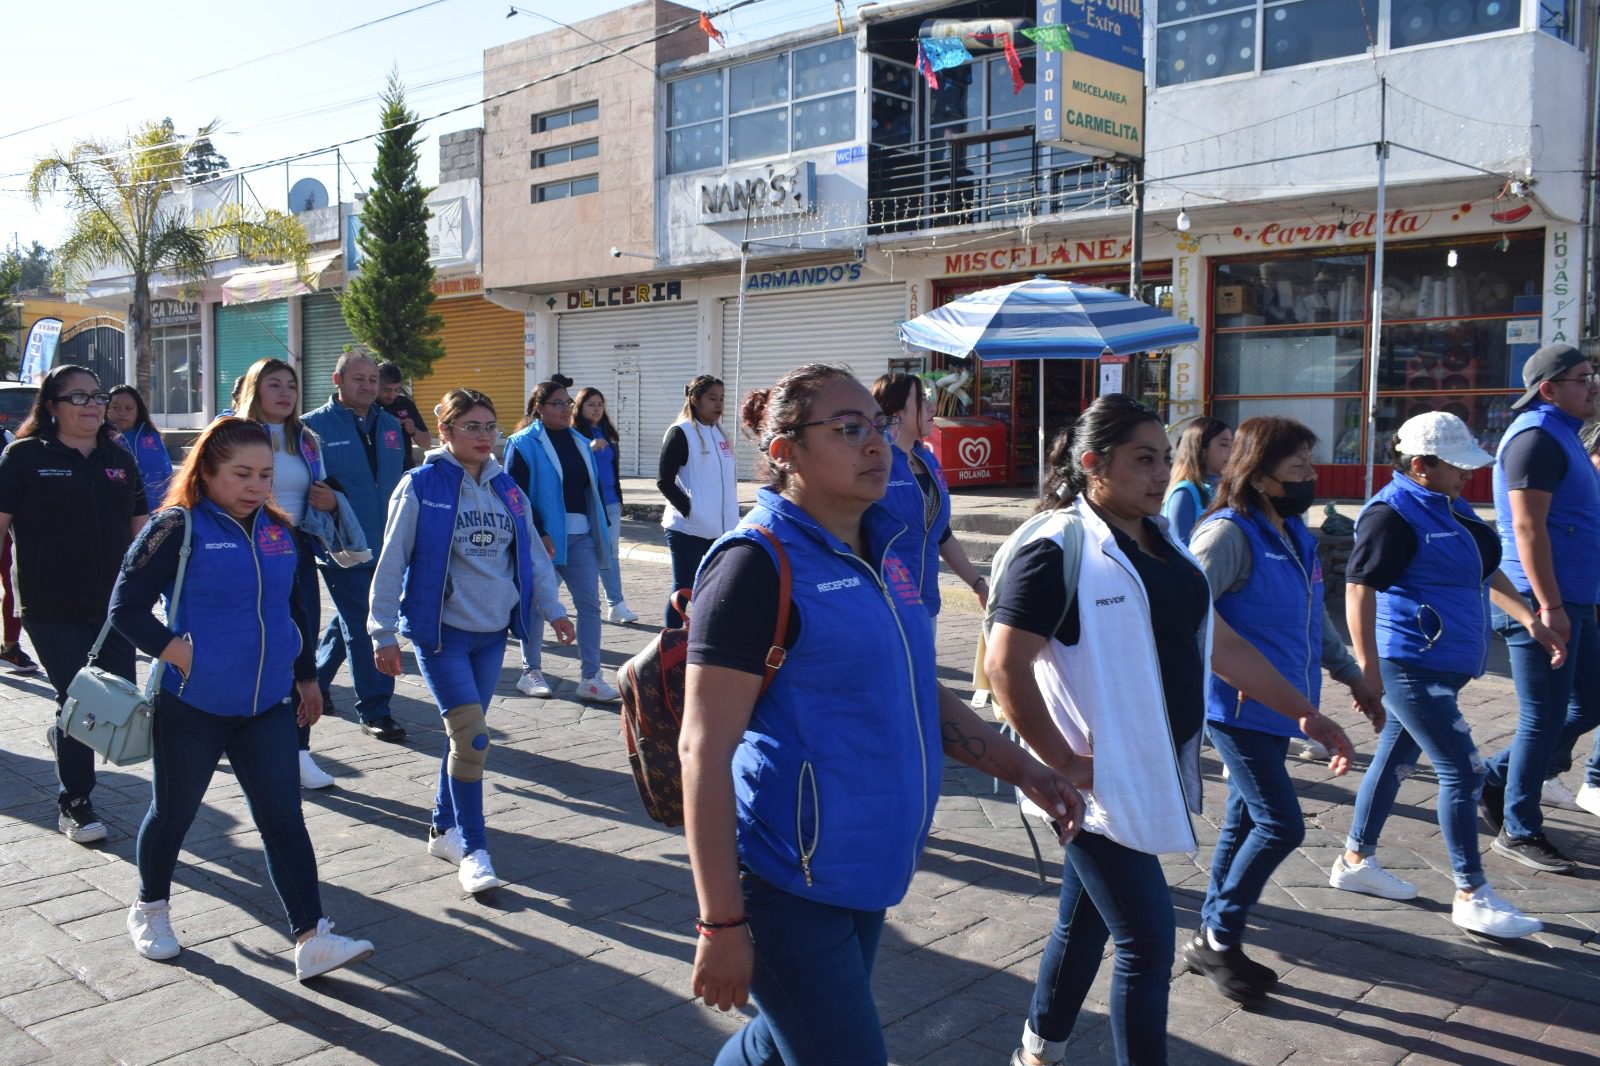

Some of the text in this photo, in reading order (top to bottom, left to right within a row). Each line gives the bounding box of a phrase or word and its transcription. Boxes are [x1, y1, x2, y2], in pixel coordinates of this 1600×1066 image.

[1086, 5, 1121, 37] Extra
[1072, 80, 1127, 105] MISCELANEA
[1066, 109, 1139, 142] CARMELITA
[701, 168, 787, 214] NANO'S
[1258, 208, 1421, 247] Carmelta
[748, 263, 863, 289] ARMANDO'S
[1553, 231, 1569, 296] HOJAS
[567, 280, 682, 310] DULCERIA
[959, 469, 991, 480] HOLANDA
[457, 510, 514, 534] ANHATTA
